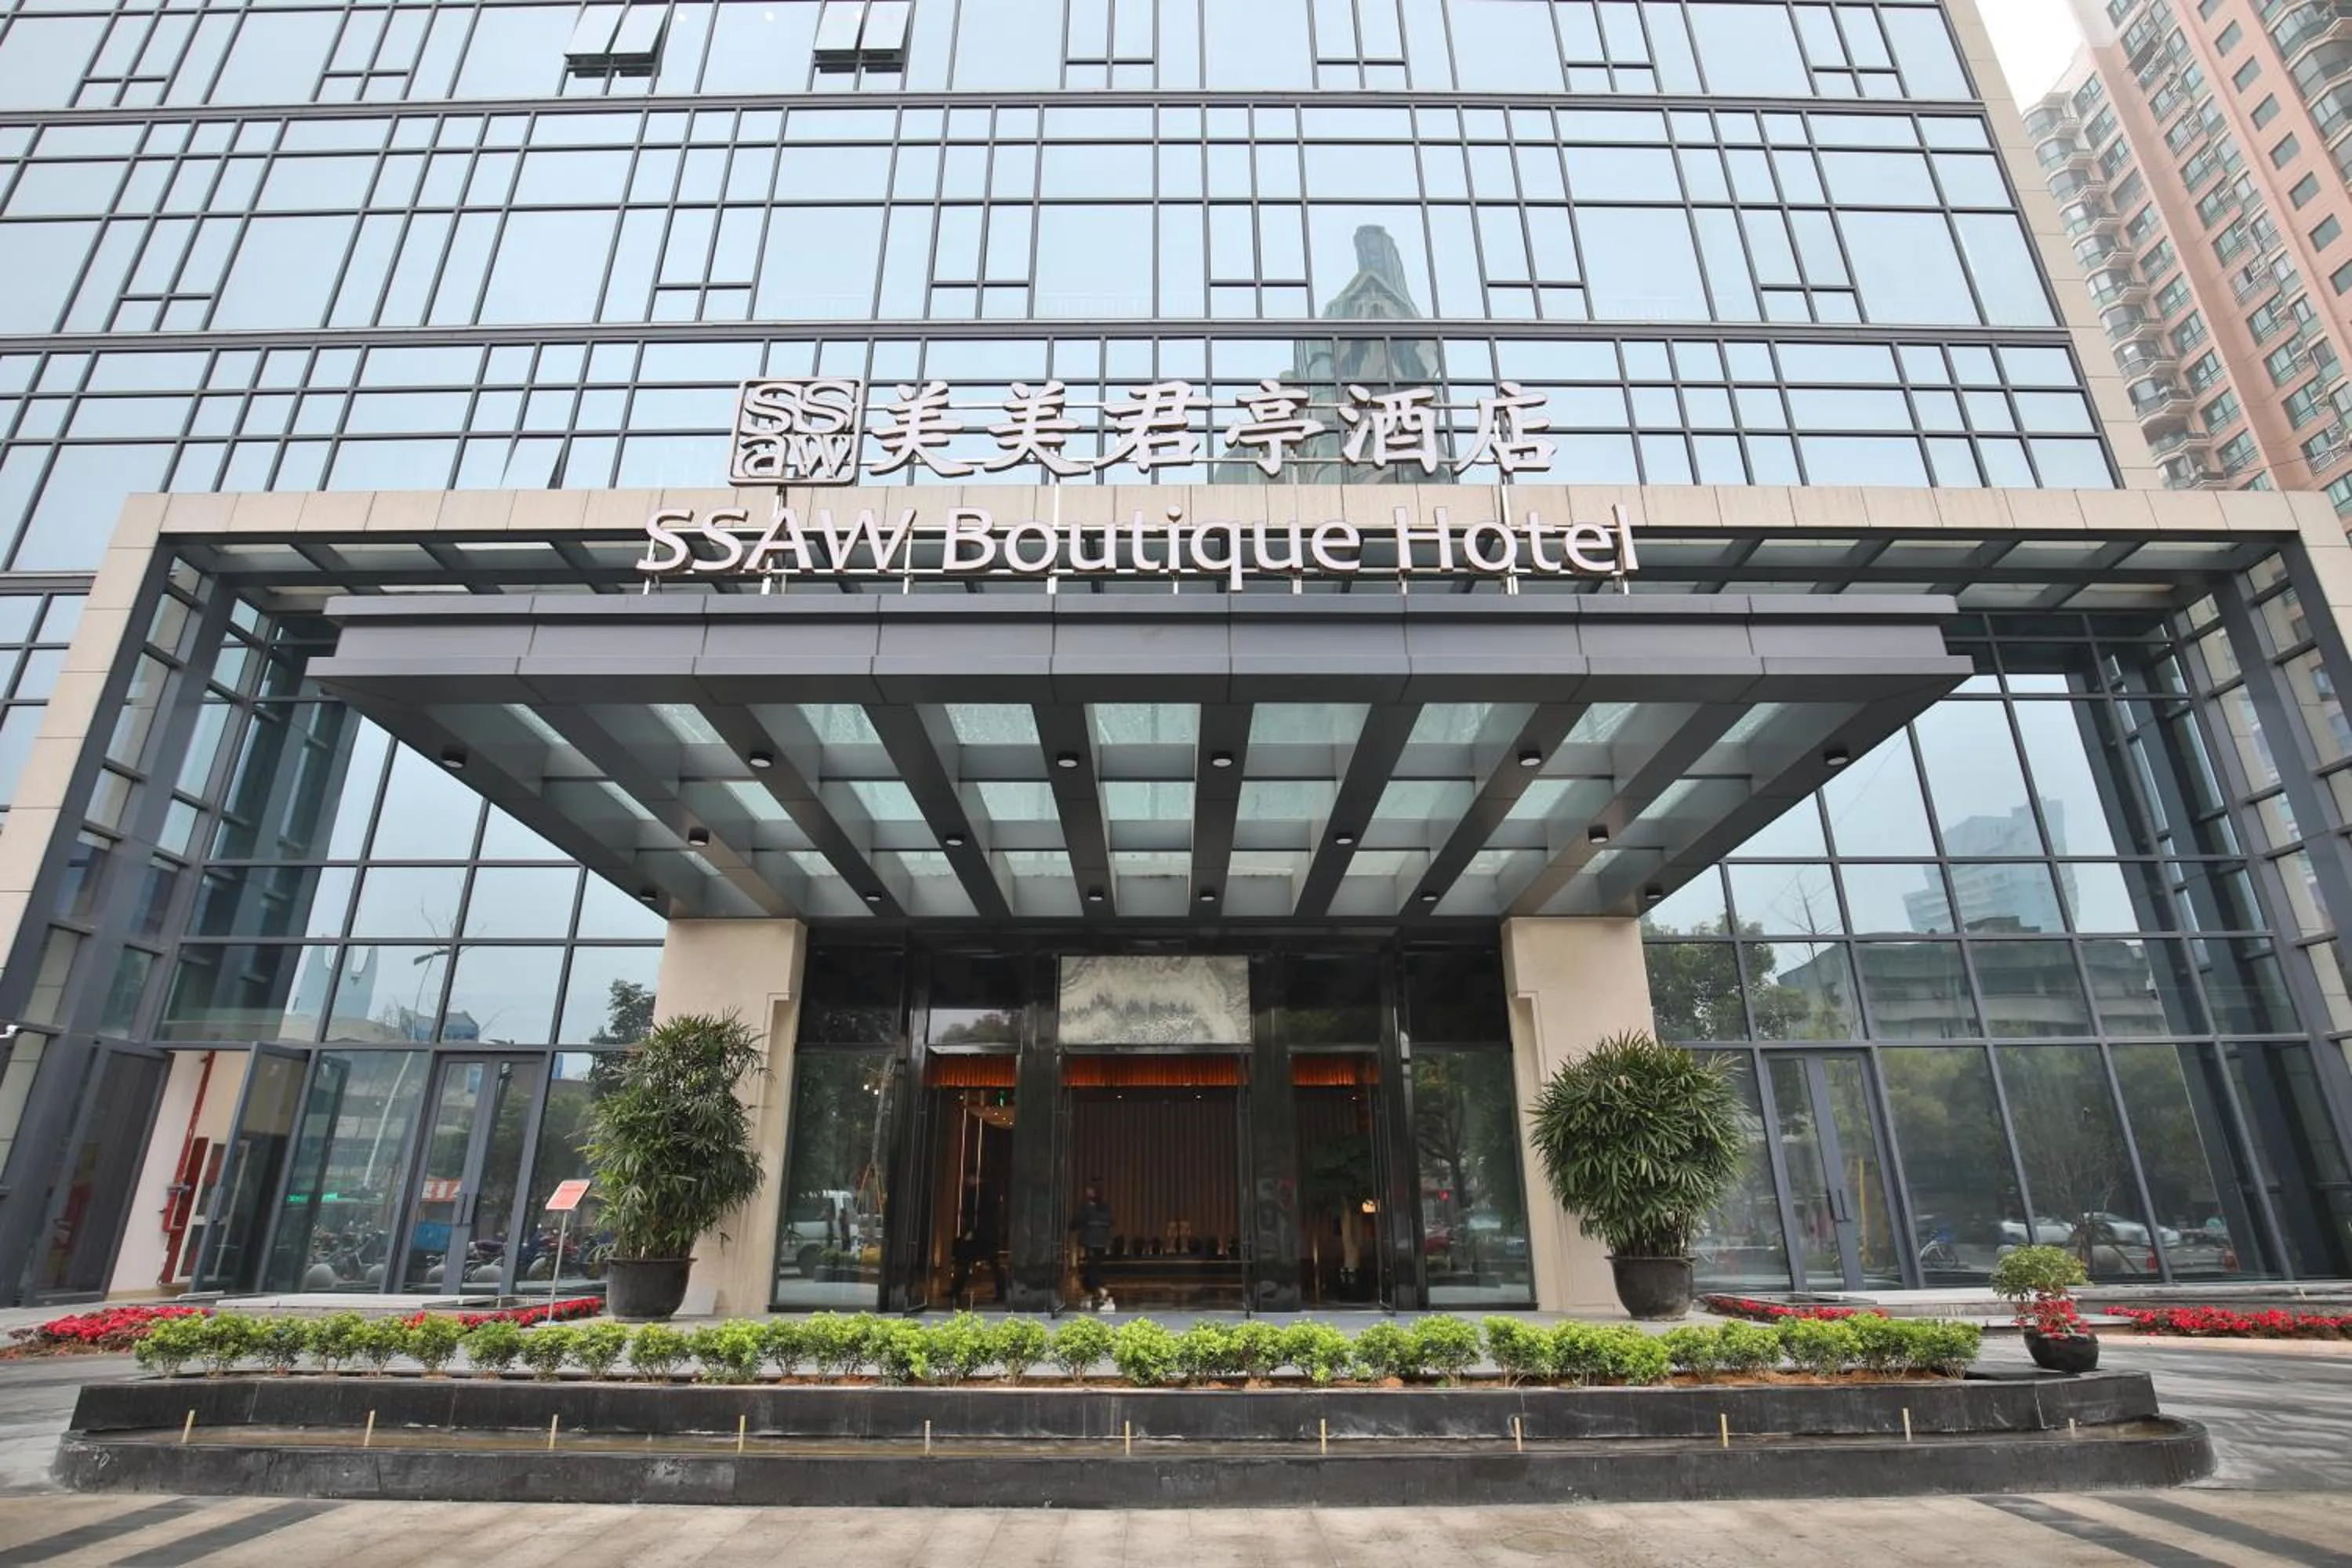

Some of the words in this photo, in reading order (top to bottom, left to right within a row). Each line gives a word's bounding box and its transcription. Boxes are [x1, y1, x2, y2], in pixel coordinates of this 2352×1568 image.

[869, 380, 1557, 477] 美美君亭酒店
[636, 507, 916, 574] SSAW
[942, 504, 1362, 592] Boutique
[1394, 503, 1639, 573] Hotel
